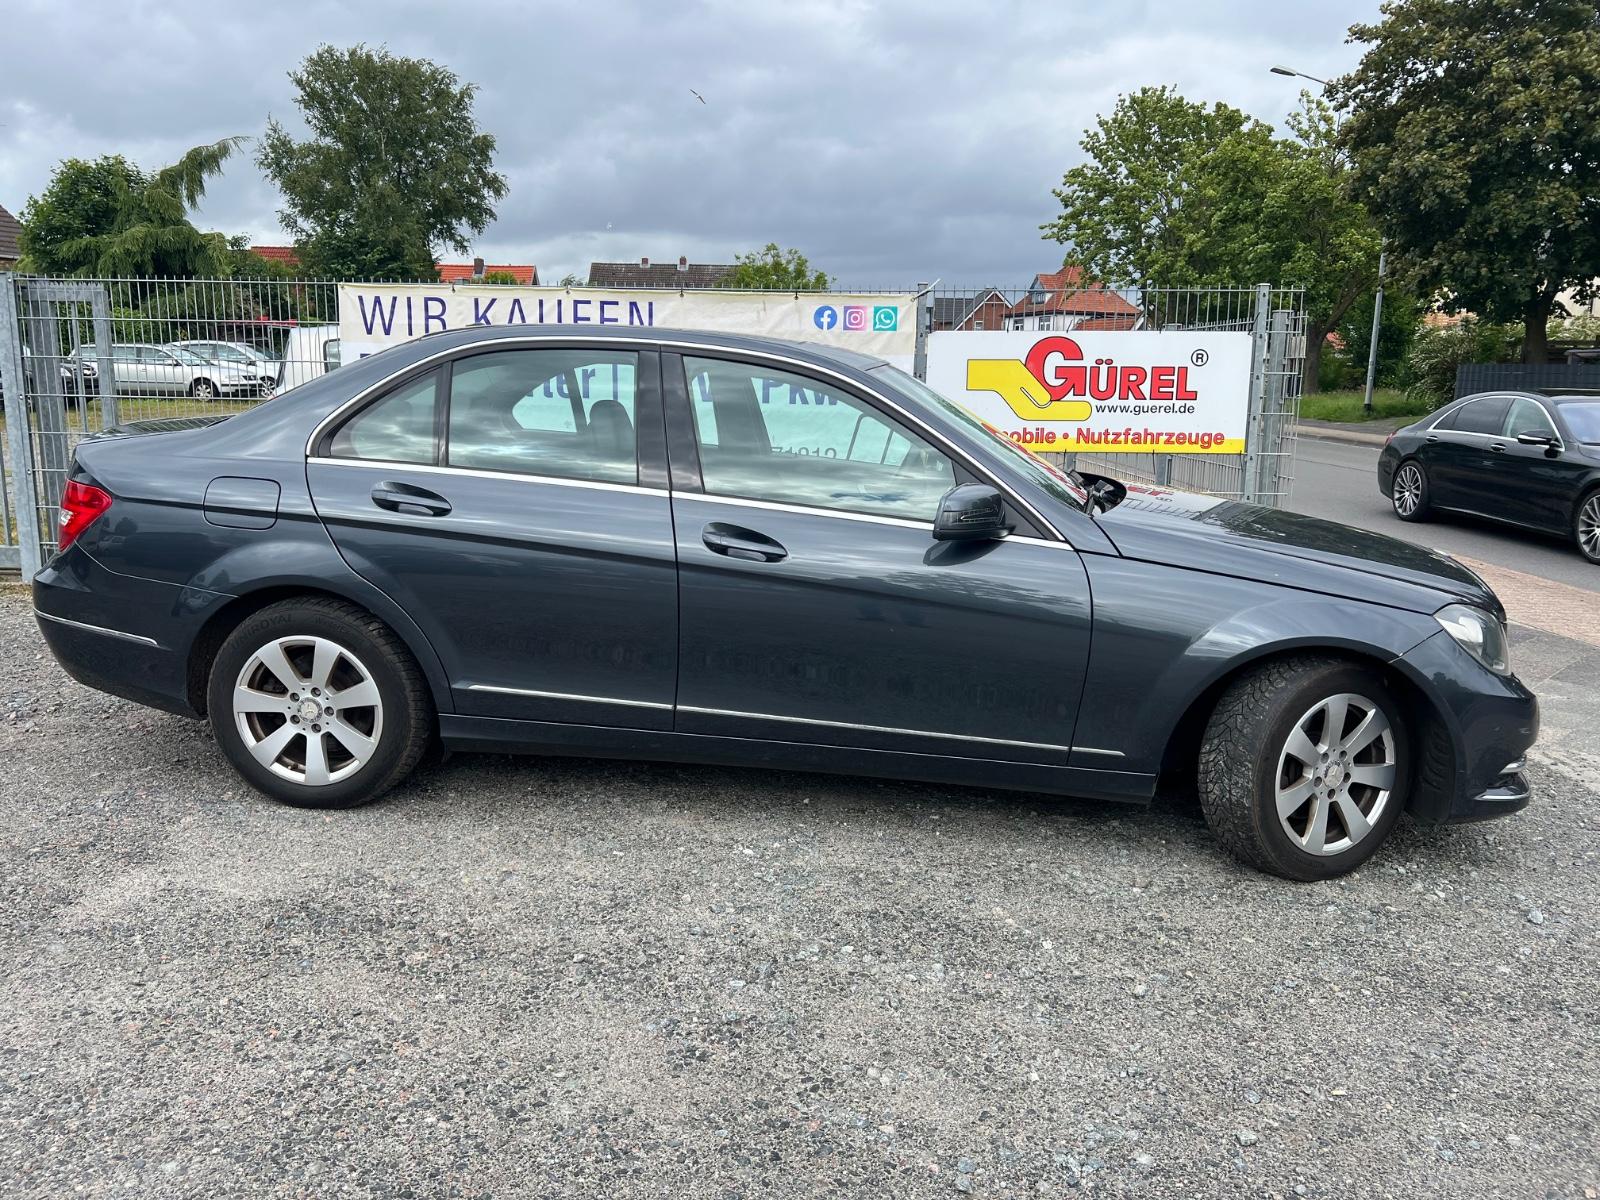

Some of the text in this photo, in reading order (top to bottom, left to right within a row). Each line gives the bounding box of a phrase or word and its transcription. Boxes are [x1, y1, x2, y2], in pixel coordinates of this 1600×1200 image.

[358, 295, 447, 336] WIR
[1025, 336, 1198, 401] GÜREL
[1095, 402, 1195, 416] www.guerel.de
[1003, 427, 1225, 449] obile Nutzfahrzeuge
